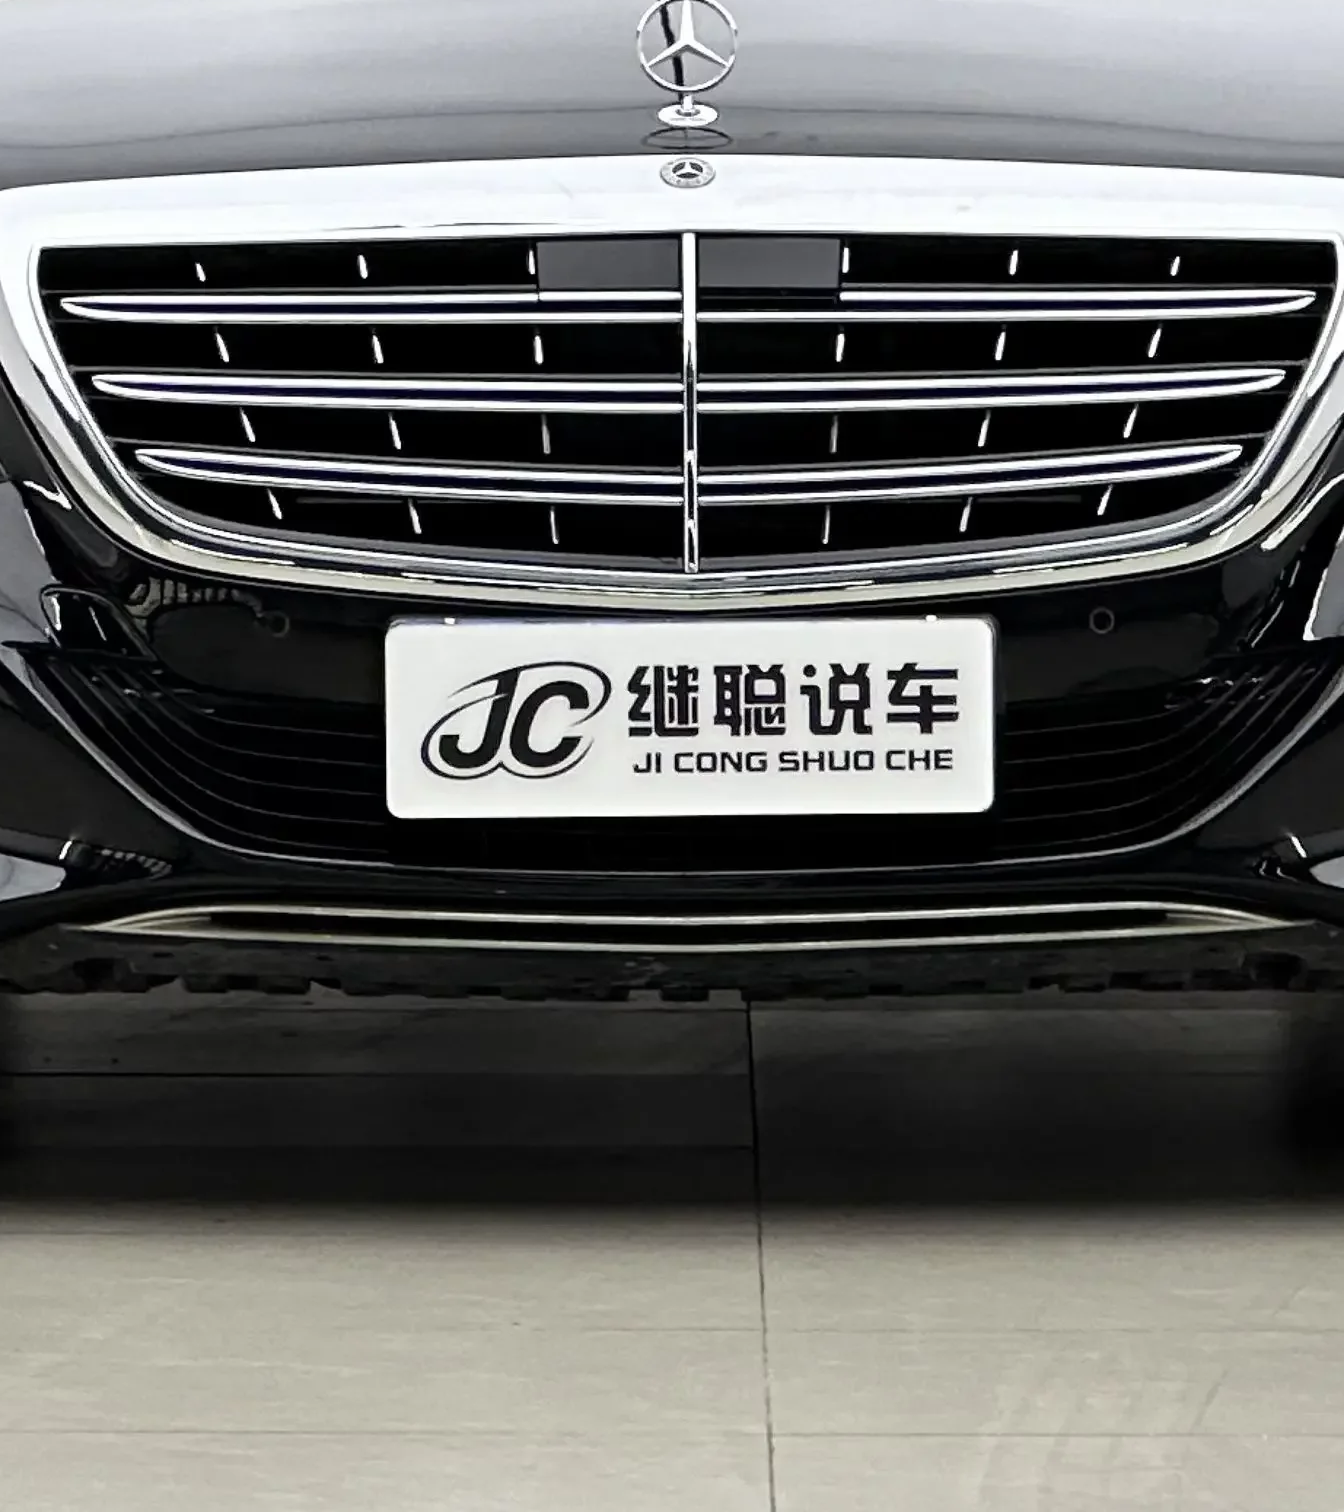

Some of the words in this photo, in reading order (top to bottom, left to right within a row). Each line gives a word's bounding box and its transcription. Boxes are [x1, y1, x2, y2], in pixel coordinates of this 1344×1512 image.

[436, 664, 592, 771] JC
[627, 662, 960, 737] 继聪说车
[633, 752, 662, 774] JI
[674, 751, 768, 773] CONG
[778, 750, 874, 772] SHUO
[885, 749, 953, 771] CHE
